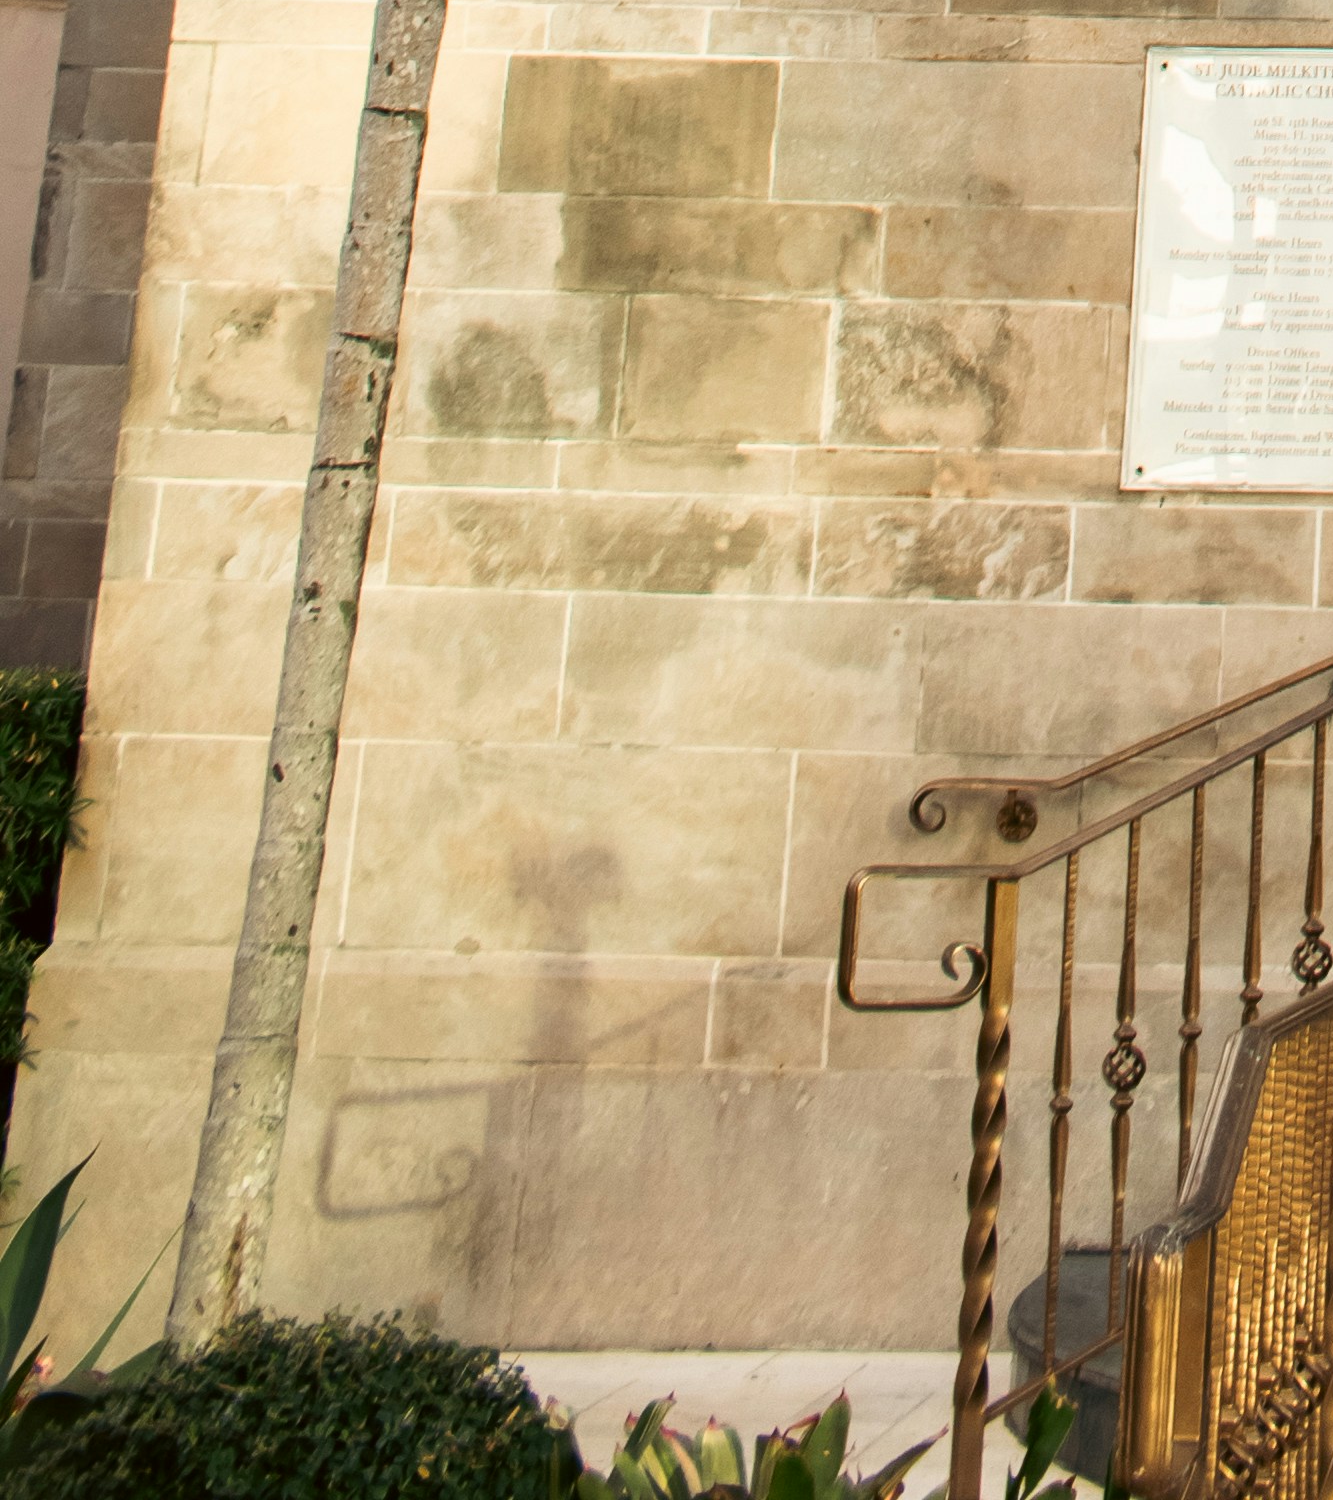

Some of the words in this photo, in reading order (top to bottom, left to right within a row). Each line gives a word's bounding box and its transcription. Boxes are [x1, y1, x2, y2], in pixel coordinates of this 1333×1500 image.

[1219, 64, 1263, 81] JUDE
[1291, 238, 1323, 249] Hours
[1169, 249, 1210, 262] Monday
[1226, 250, 1269, 264] Saturday
[1252, 291, 1285, 303] Office
[1288, 292, 1320, 304] Hours
[1247, 346, 1281, 358] Divine
[1284, 347, 1320, 359] Offices
[1179, 359, 1216, 373] Sunday
[1268, 361, 1301, 372] Divine
[1267, 375, 1300, 387] Divine
[1267, 388, 1307, 402] Liturga
[1302, 432, 1321, 443] and
[1254, 447, 1319, 458] appointment
